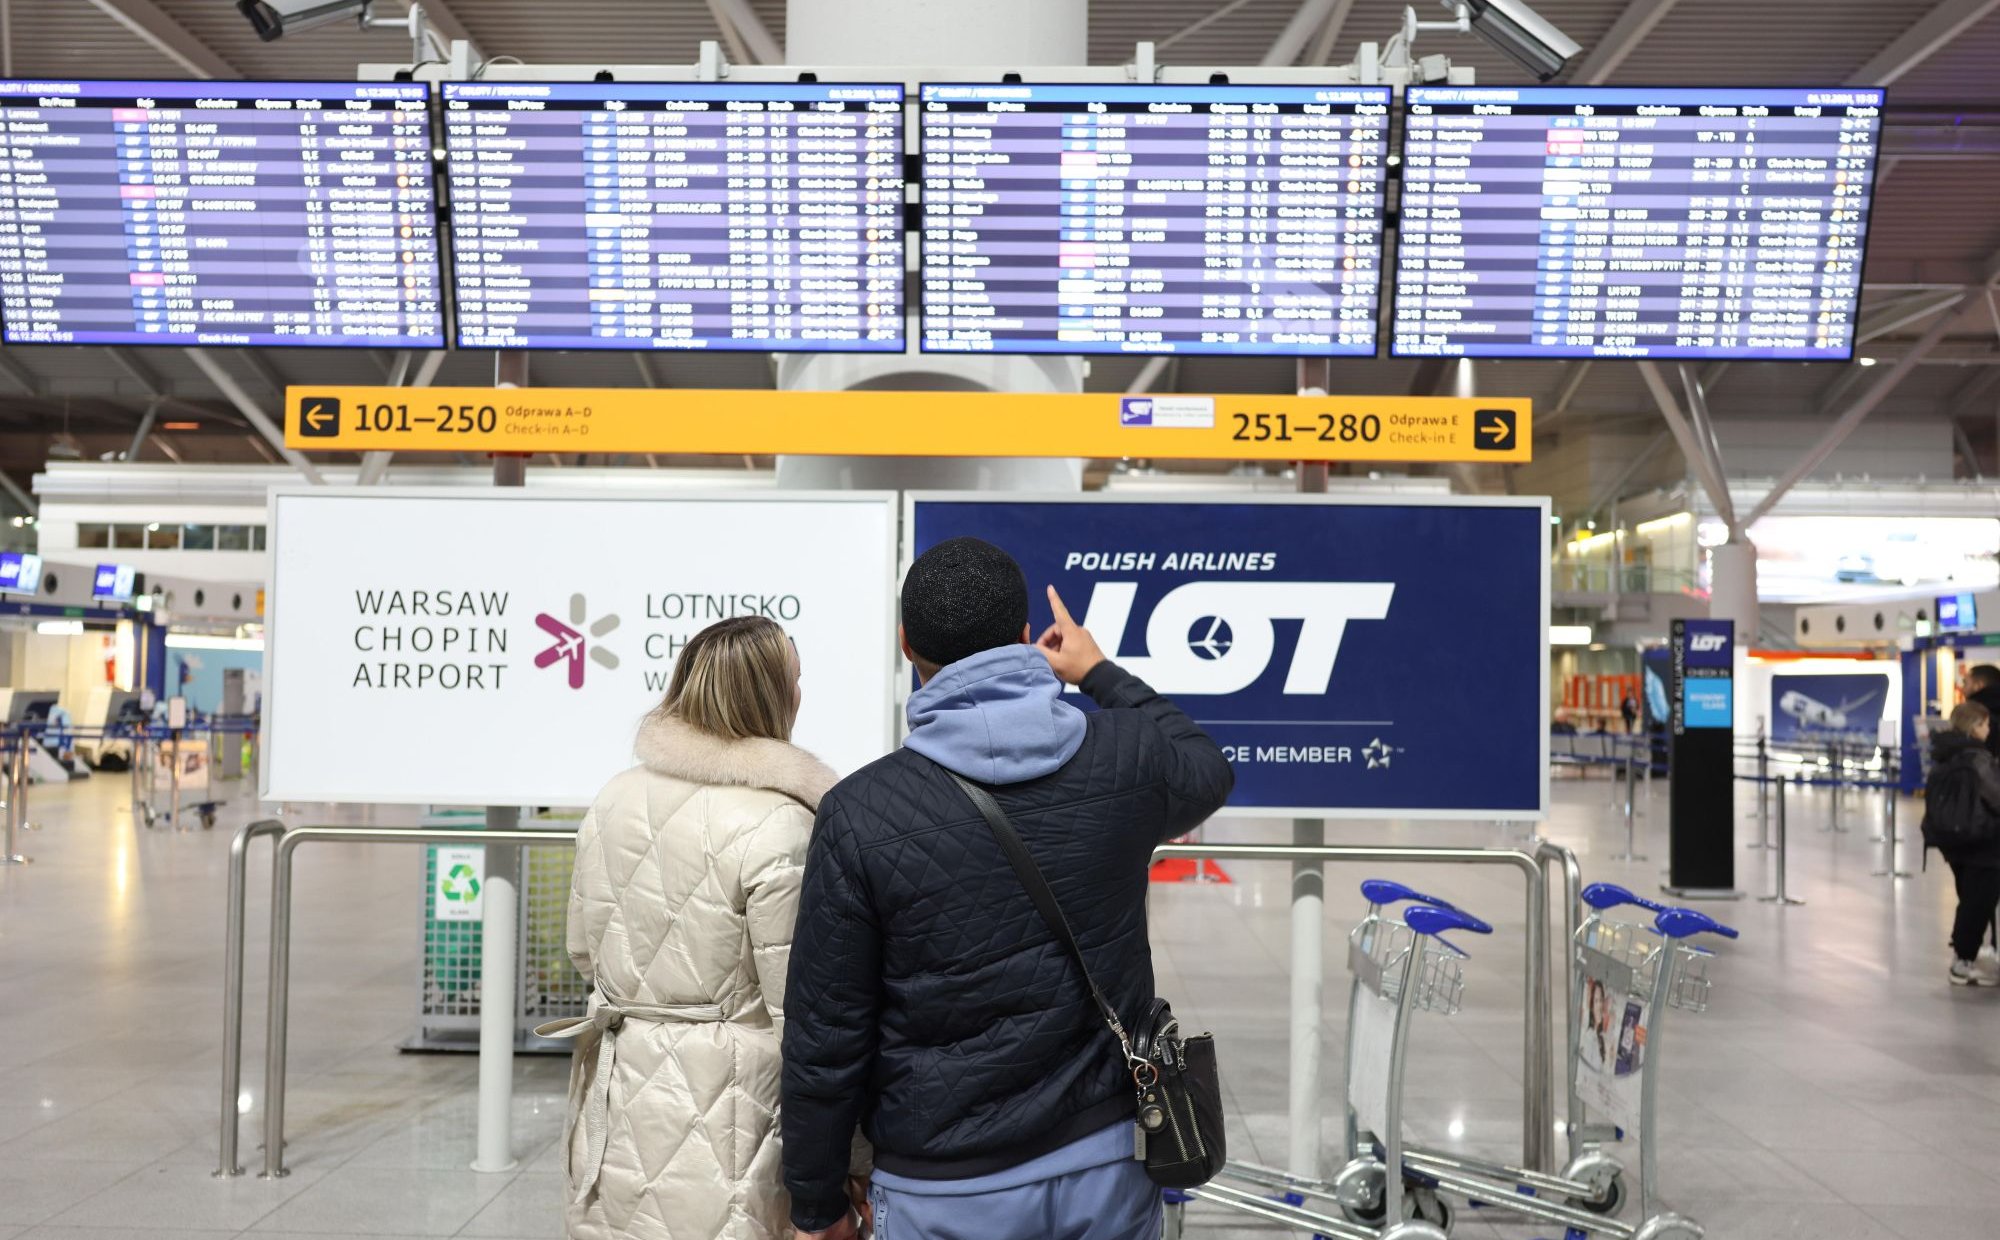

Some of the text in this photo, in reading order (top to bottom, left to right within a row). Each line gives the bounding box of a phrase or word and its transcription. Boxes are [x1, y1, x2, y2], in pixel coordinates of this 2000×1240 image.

[27, 83, 80, 94] DEPARTURES
[506, 406, 561, 418] Odprawa
[505, 424, 558, 433] Check-in
[1390, 415, 1457, 427] Odprawa E
[1390, 432, 1455, 443] Check-in E
[1065, 552, 1277, 571] POLISH AIRLINES
[356, 591, 508, 615] WARSAW
[646, 593, 801, 620] LOTNISKO
[355, 627, 506, 652] CHOPIN
[1064, 582, 1396, 694] LOT
[1690, 634, 1727, 651] LOT
[353, 664, 506, 688] AIRPORT
[1256, 746, 1351, 763] MEMBER
